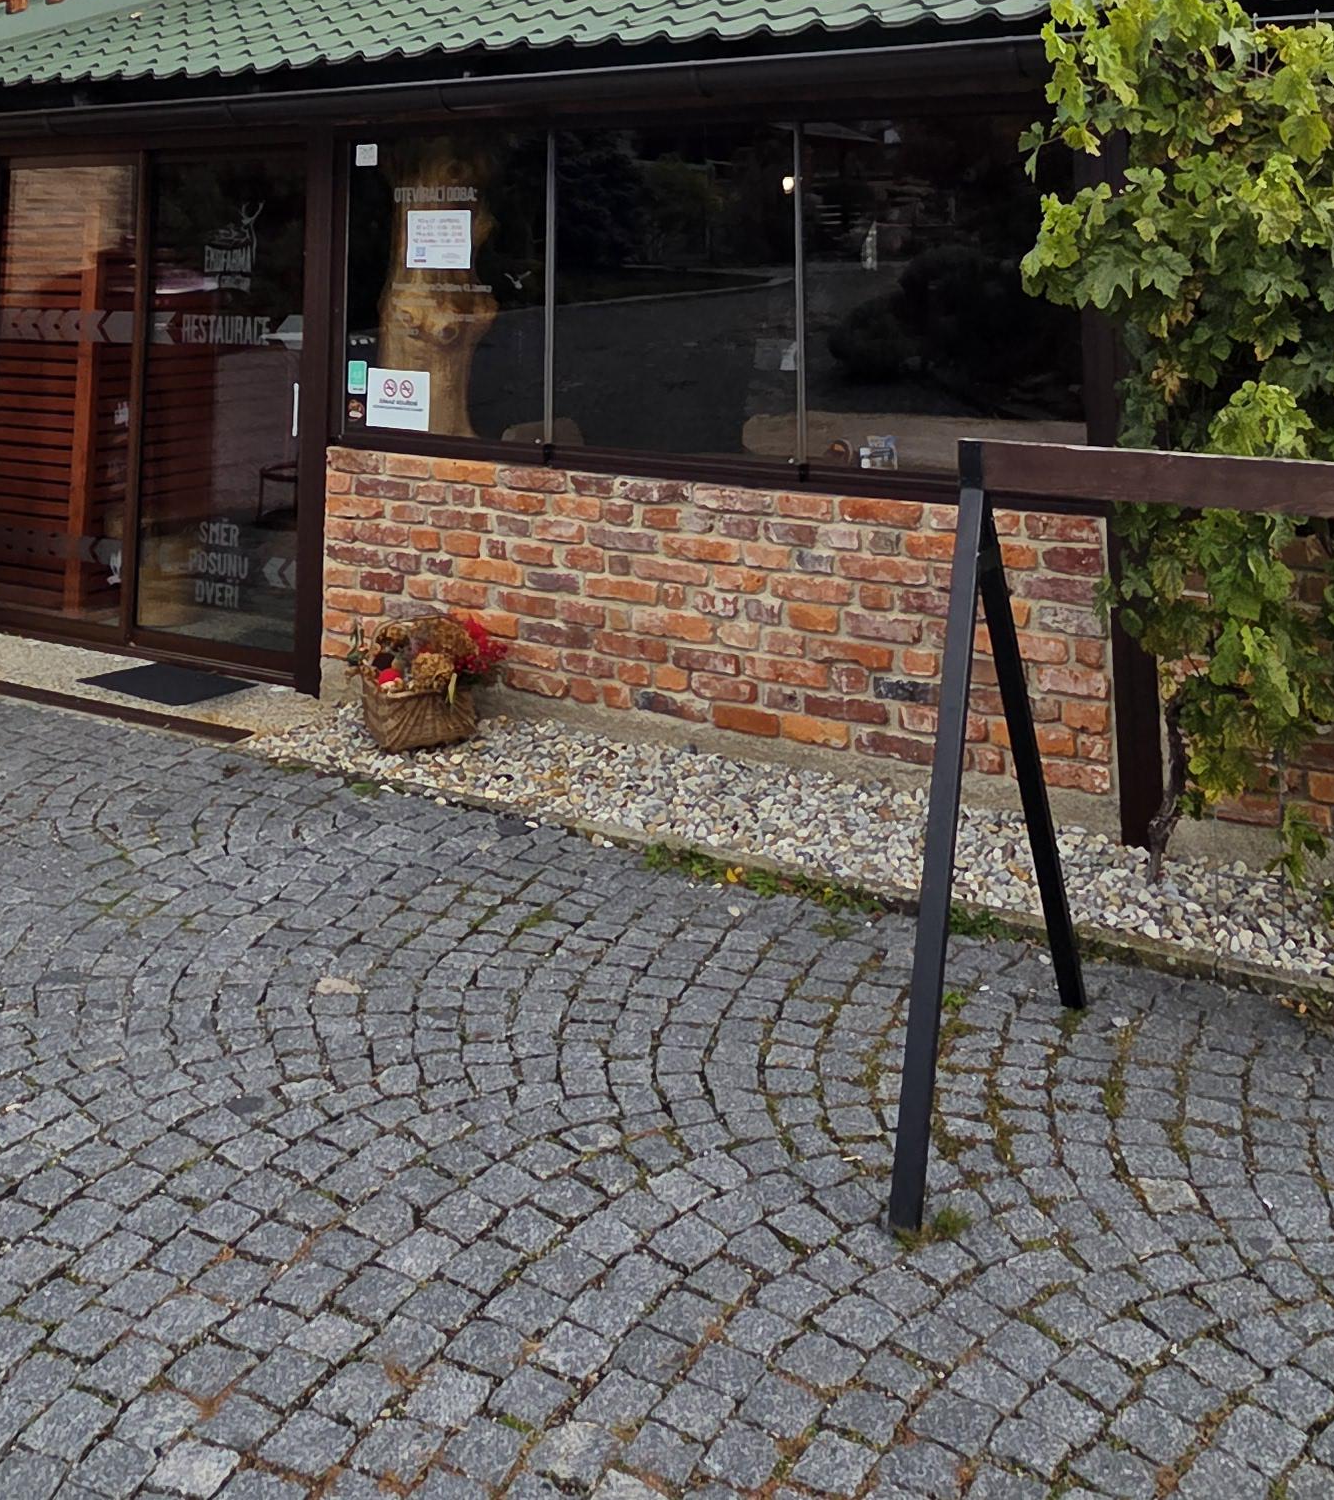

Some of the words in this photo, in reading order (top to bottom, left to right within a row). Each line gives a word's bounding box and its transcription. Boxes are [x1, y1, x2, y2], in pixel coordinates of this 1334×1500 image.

[182, 313, 271, 346] RESTAURACE
[199, 517, 240, 548] SMĚR
[188, 550, 249, 580] POSUNU
[195, 578, 240, 608] DVEŘÍ
